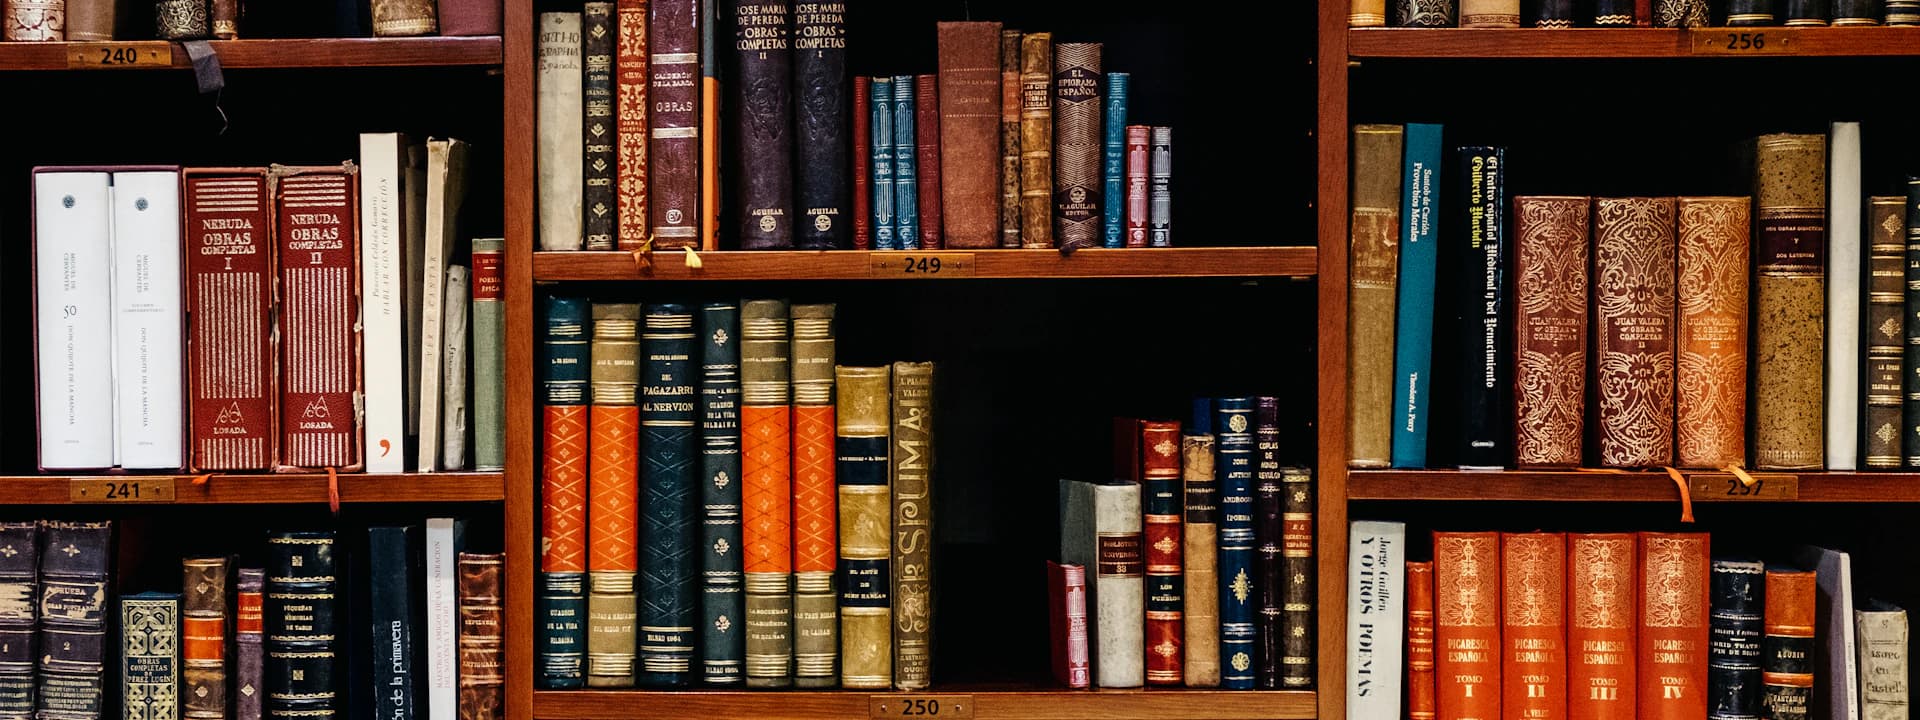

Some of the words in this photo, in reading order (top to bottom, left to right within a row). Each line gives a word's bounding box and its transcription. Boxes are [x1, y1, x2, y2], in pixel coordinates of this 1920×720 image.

[736, 5, 759, 15] JOSE
[760, 5, 787, 15] MARIA
[794, 3, 818, 14] JOSE
[819, 3, 846, 13] MARIA
[738, 16, 749, 25] DE
[751, 15, 785, 25] PEREDA
[797, 14, 807, 24] DE
[810, 14, 844, 24] PEREDA
[744, 27, 778, 38] OBRAS
[803, 26, 836, 37] OBRAS
[736, 38, 787, 50] COMPLETAS
[795, 37, 845, 49] COMPLETAS
[1727, 33, 1765, 49] 256
[101, 47, 138, 65] 240
[818, 50, 823, 58] I
[1071, 69, 1084, 78] EL
[1058, 79, 1097, 87] EPIGRAMA
[1058, 85, 1096, 96] ESPAÑOL
[655, 101, 693, 112] OBRAS
[1485, 156, 1496, 170] El
[1411, 162, 1423, 207] Proverbios
[1422, 168, 1432, 196] Santob
[1472, 156, 1483, 204] Edilberto
[1485, 171, 1496, 200] teatro
[1422, 196, 1431, 205] de
[752, 208, 784, 216] AGUILAR
[807, 207, 839, 216] AGUILAR
[202, 218, 253, 230] NERUDA
[290, 214, 340, 225] NERUDA
[1410, 207, 1421, 243] Morales
[1421, 206, 1431, 235] Carrión
[1484, 202, 1497, 241] español
[203, 233, 251, 246] OBRAS
[291, 228, 339, 241] OBRAS
[201, 245, 256, 255] COMPLETAS
[289, 240, 343, 250] COMPLETAS
[224, 257, 232, 270] I
[310, 252, 323, 264] II
[904, 257, 941, 273] 249
[1483, 291, 1494, 299] y
[63, 305, 77, 320] 50
[1486, 301, 1497, 315] del
[1529, 317, 1552, 326] JUAN
[1553, 317, 1581, 326] VALERA
[1614, 317, 1637, 326] JUAN
[1638, 317, 1666, 326] VALERA
[1687, 317, 1711, 326] JUAN
[1711, 317, 1740, 326] VALERA
[1544, 326, 1570, 334] OBRAS
[1533, 333, 1577, 341] COMPLETAS
[1692, 333, 1737, 341] COMPLETAS
[1484, 317, 1497, 388] Renacimiento
[643, 386, 694, 396] PAGAZARRI
[642, 403, 652, 411] AL
[653, 402, 694, 412] NERVION
[1408, 404, 1417, 412] A.
[299, 421, 334, 430] LOSADA
[1259, 442, 1279, 450] COPLAS
[1264, 451, 1273, 459] DE
[105, 483, 140, 499] 241
[898, 406, 928, 581] ESPUMA
[1360, 536, 1375, 549] Y
[1377, 537, 1391, 568] Jorge
[1116, 565, 1127, 573] 33
[1359, 554, 1375, 615] OTROS
[63, 641, 71, 651] 2
[389, 620, 407, 674] primavera
[1448, 639, 1490, 650] PICARESCA
[1515, 639, 1555, 650] PICARESCA
[1584, 640, 1625, 651] PICARESCA
[1654, 639, 1695, 651] PICARESCA
[137, 657, 160, 665] OBRAS
[1358, 624, 1374, 697] POEMAS
[1448, 650, 1488, 663] ESPAÑOLA
[1515, 650, 1555, 663] ESPAÑOLA
[1584, 652, 1624, 664] ESPAÑOLA
[1654, 651, 1694, 663] ESPAÑOLA
[389, 677, 403, 686] la
[1455, 675, 1483, 683] TOMO
[1522, 675, 1549, 683] TOMO
[1590, 678, 1618, 686] TOMO
[1660, 677, 1688, 685] TOMO
[1465, 685, 1473, 698] I
[1527, 685, 1545, 698] II
[1590, 686, 1618, 700] III
[1664, 686, 1686, 699] IV
[390, 689, 404, 706] de
[902, 699, 939, 715] 250
